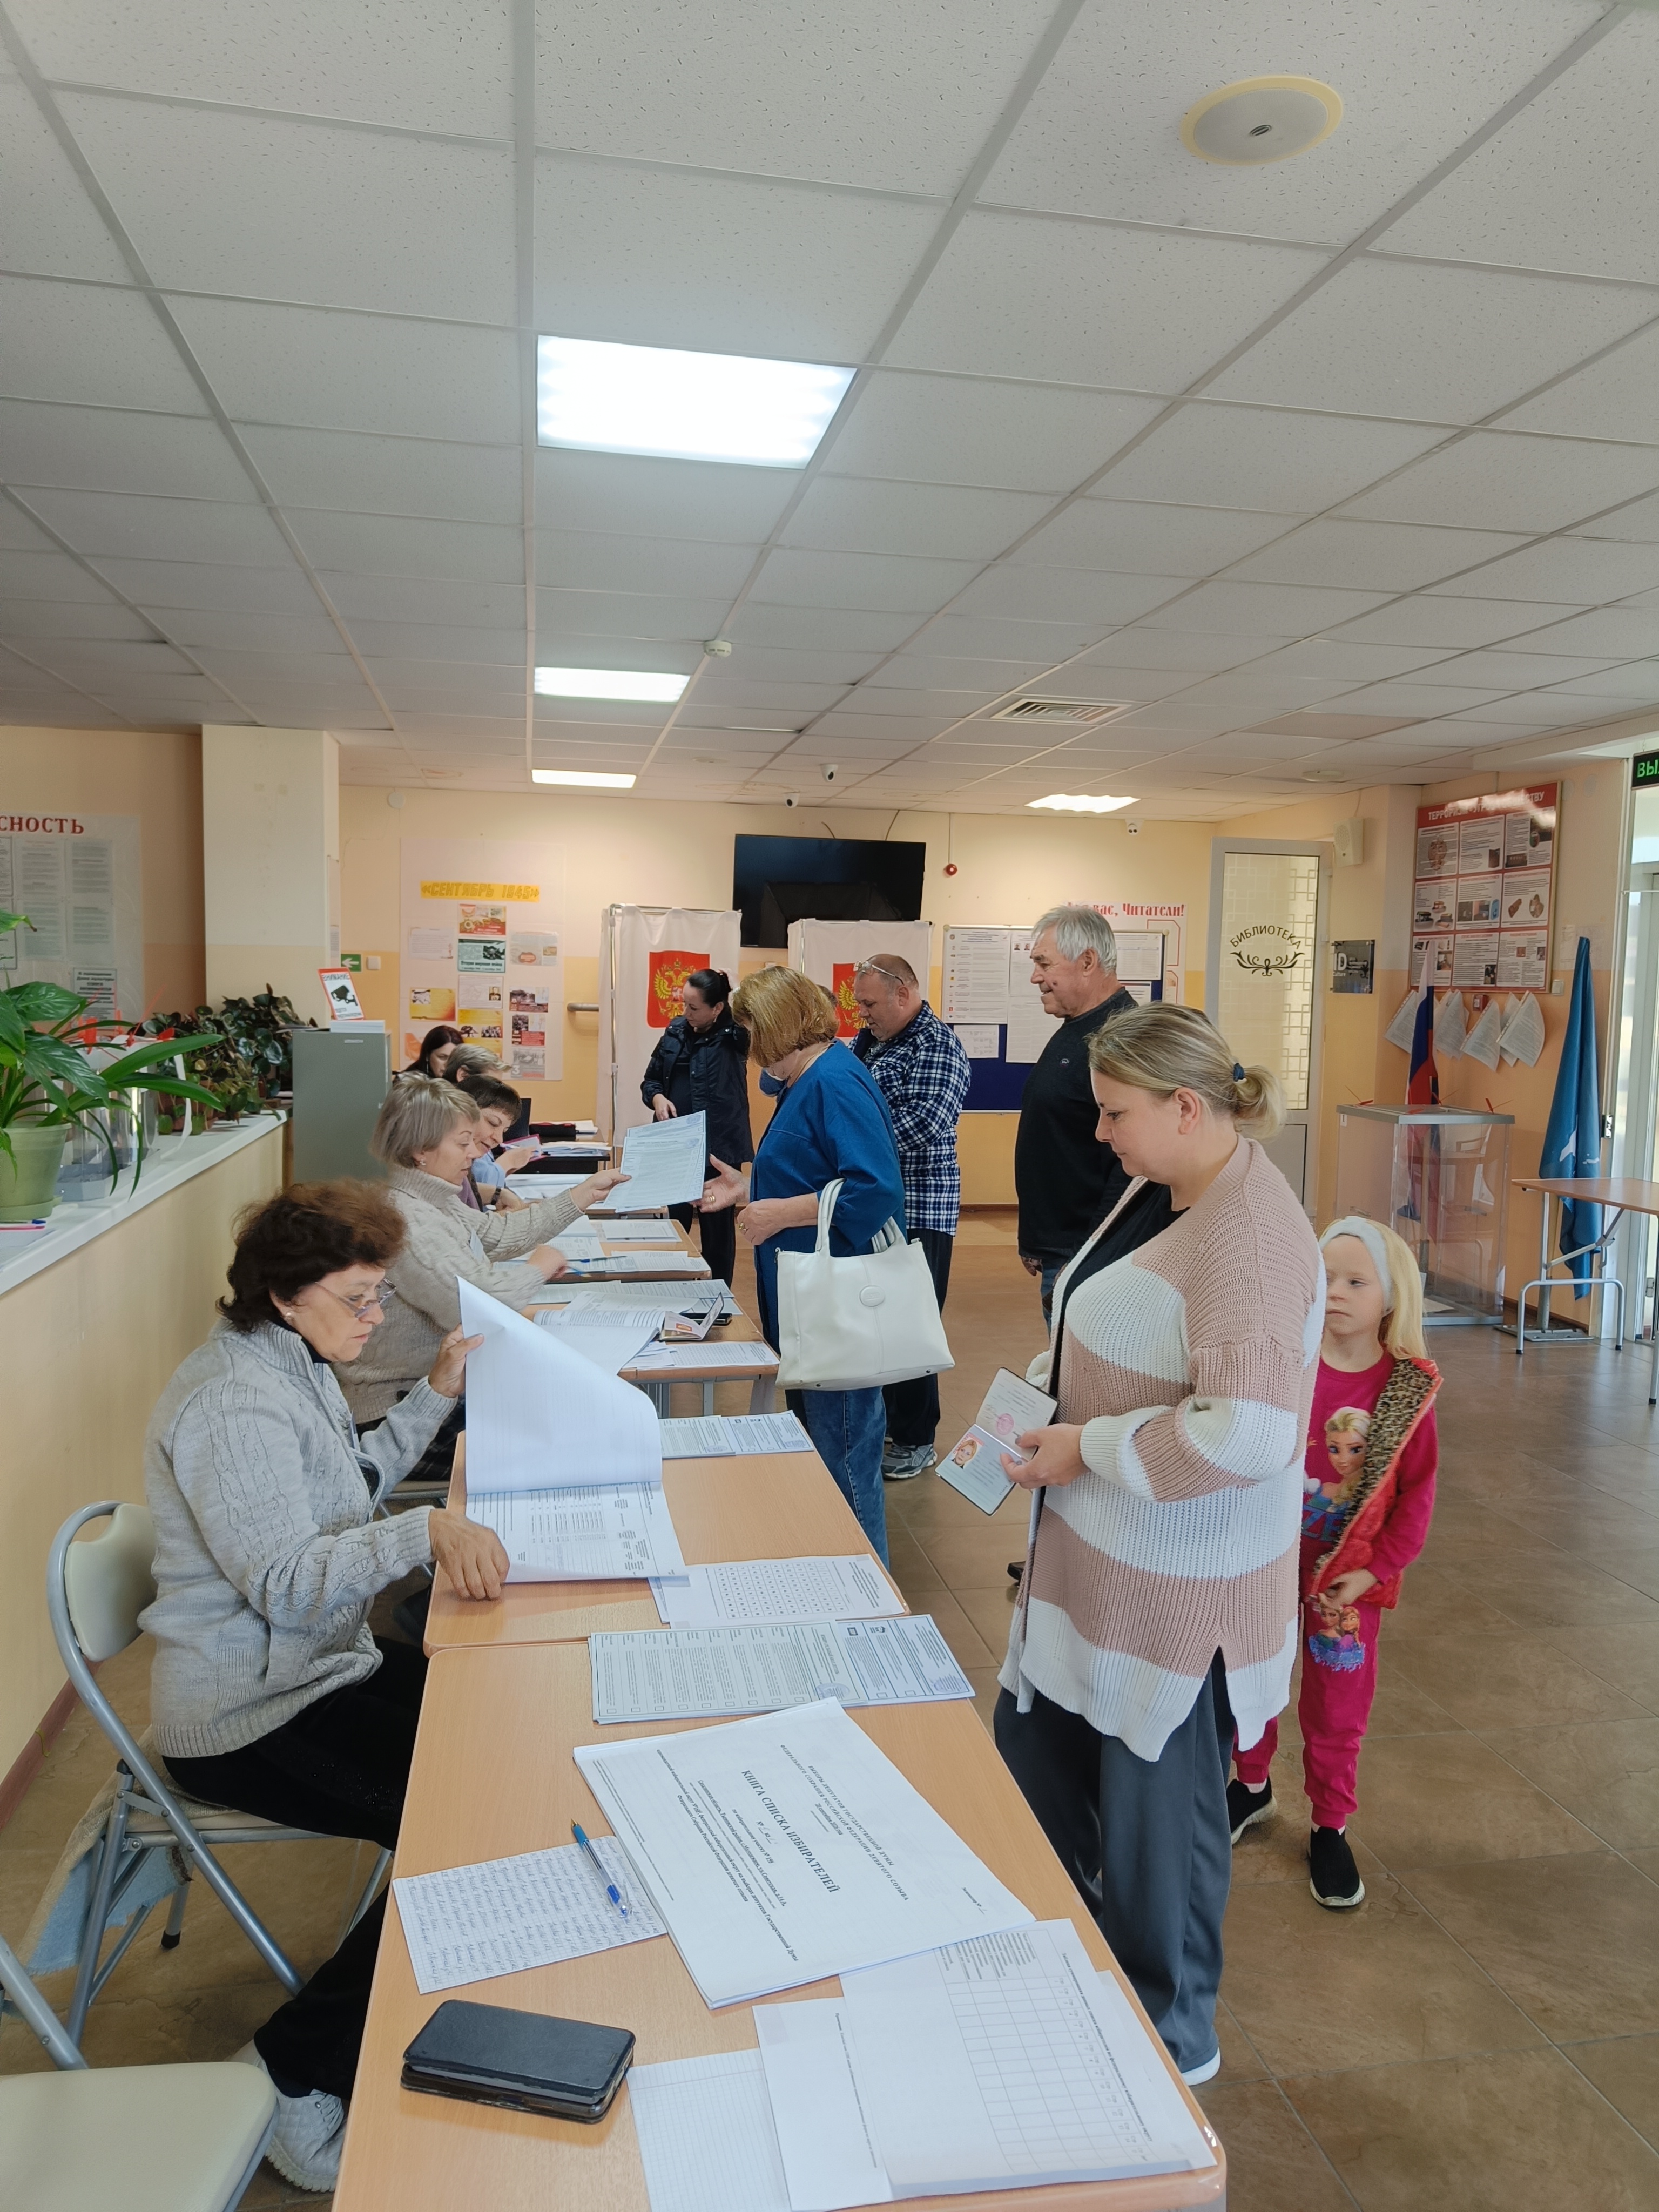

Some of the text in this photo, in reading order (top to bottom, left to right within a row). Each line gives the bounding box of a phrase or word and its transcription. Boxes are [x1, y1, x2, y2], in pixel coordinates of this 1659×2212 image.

[1637, 759, 1659, 778] ВЫ
[1123, 903, 1184, 916] Читатели!
[1230, 925, 1301, 949] БИБЛИОТЕКА
[740, 1770, 766, 1796] КНИГА
[761, 1797, 791, 1831] СПИСКА
[785, 1831, 841, 1892] ИЗБИРАТЕЛЕЙ
[779, 1744, 807, 1773] ФЕДЕРАЛЬНОГО
[804, 1774, 825, 1797] СОБРАНИЯ
[821, 1797, 849, 1826] РОССИЙСКОЙ
[846, 1826, 871, 1852] ФЕДЕРАЦИИ
[867, 1853, 892, 1878] ДЕВЯТОГО
[889, 1879, 909, 1900] СОЗЫВА
[807, 1765, 894, 1866] ВЫБОРЫ ДЕПУТАТОВ ГОСУДАРСТВЕННОЙ ДУМЫ
